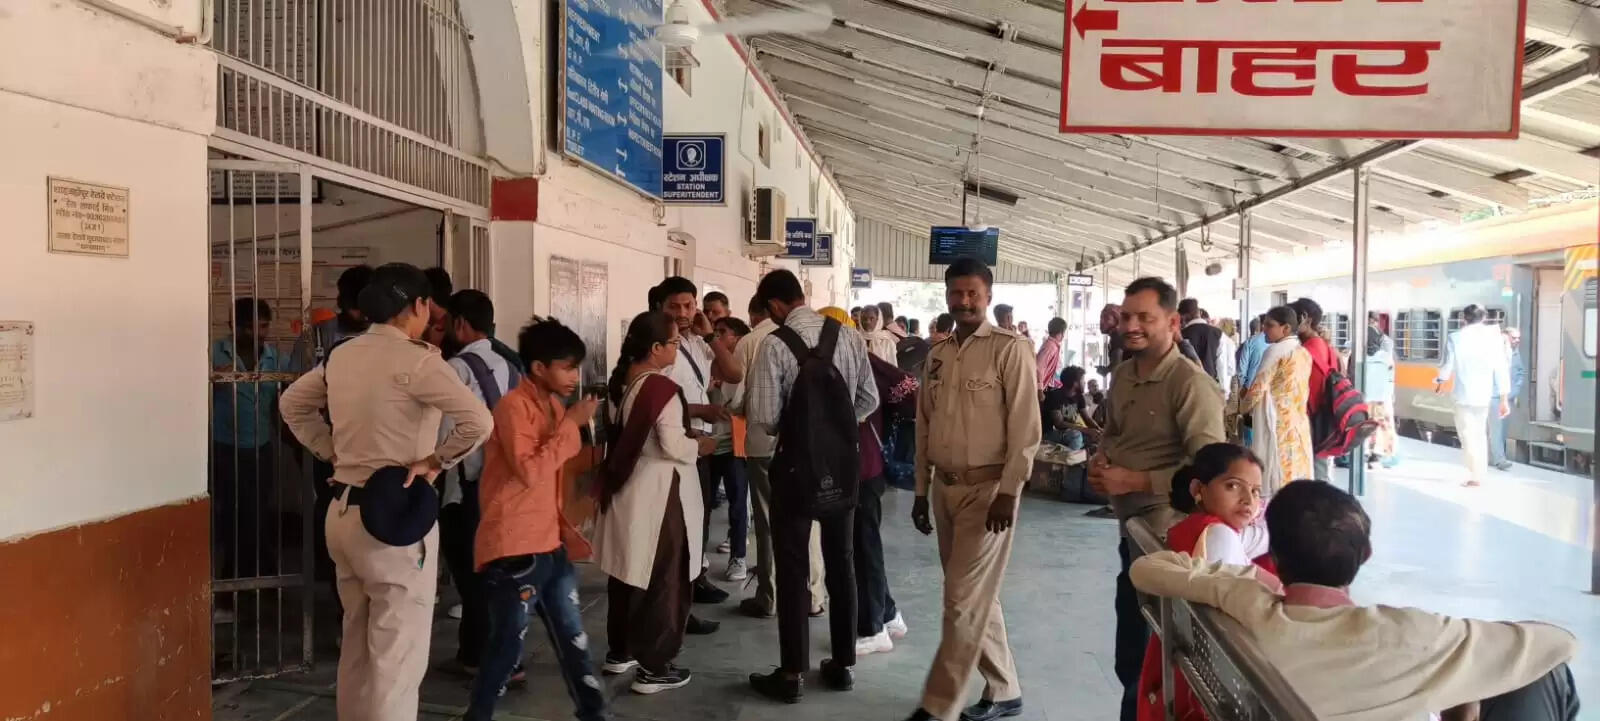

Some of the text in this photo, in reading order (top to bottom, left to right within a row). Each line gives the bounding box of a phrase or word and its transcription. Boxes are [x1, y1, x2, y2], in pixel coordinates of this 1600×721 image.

[1100, 38, 1441, 97] बाहर
[663, 170, 719, 182] स्टेशन अधीक्षक
